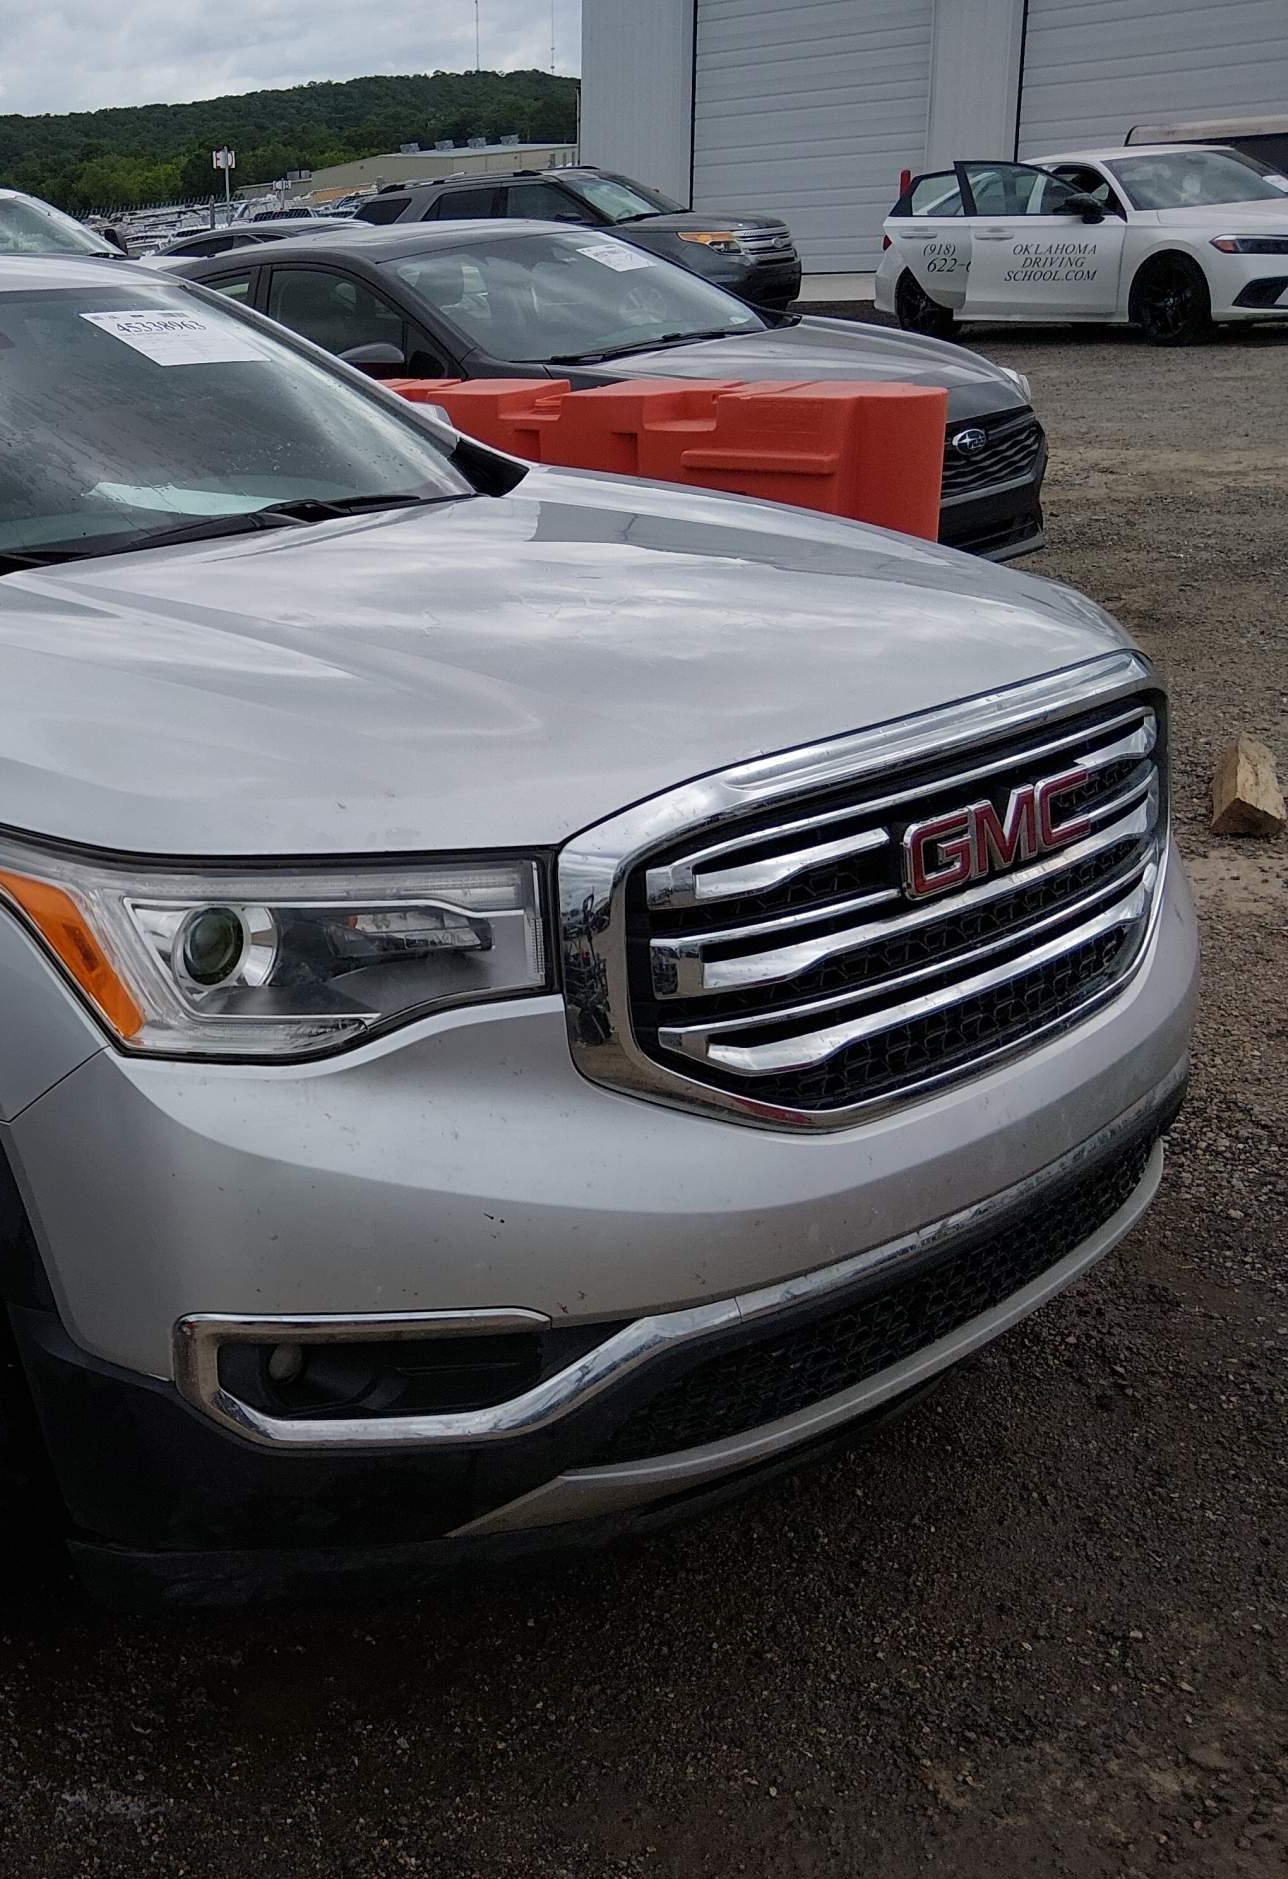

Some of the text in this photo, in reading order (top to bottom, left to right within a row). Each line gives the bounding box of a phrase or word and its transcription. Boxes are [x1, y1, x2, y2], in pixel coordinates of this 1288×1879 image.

[923, 243, 956, 257] (918)
[1012, 243, 1097, 255] OKLAHOMA
[1022, 256, 1086, 268] DRIVING
[1004, 269, 1097, 281] SCHOOL.COM
[116, 320, 207, 333] 45338963
[903, 766, 1091, 900] GMC
